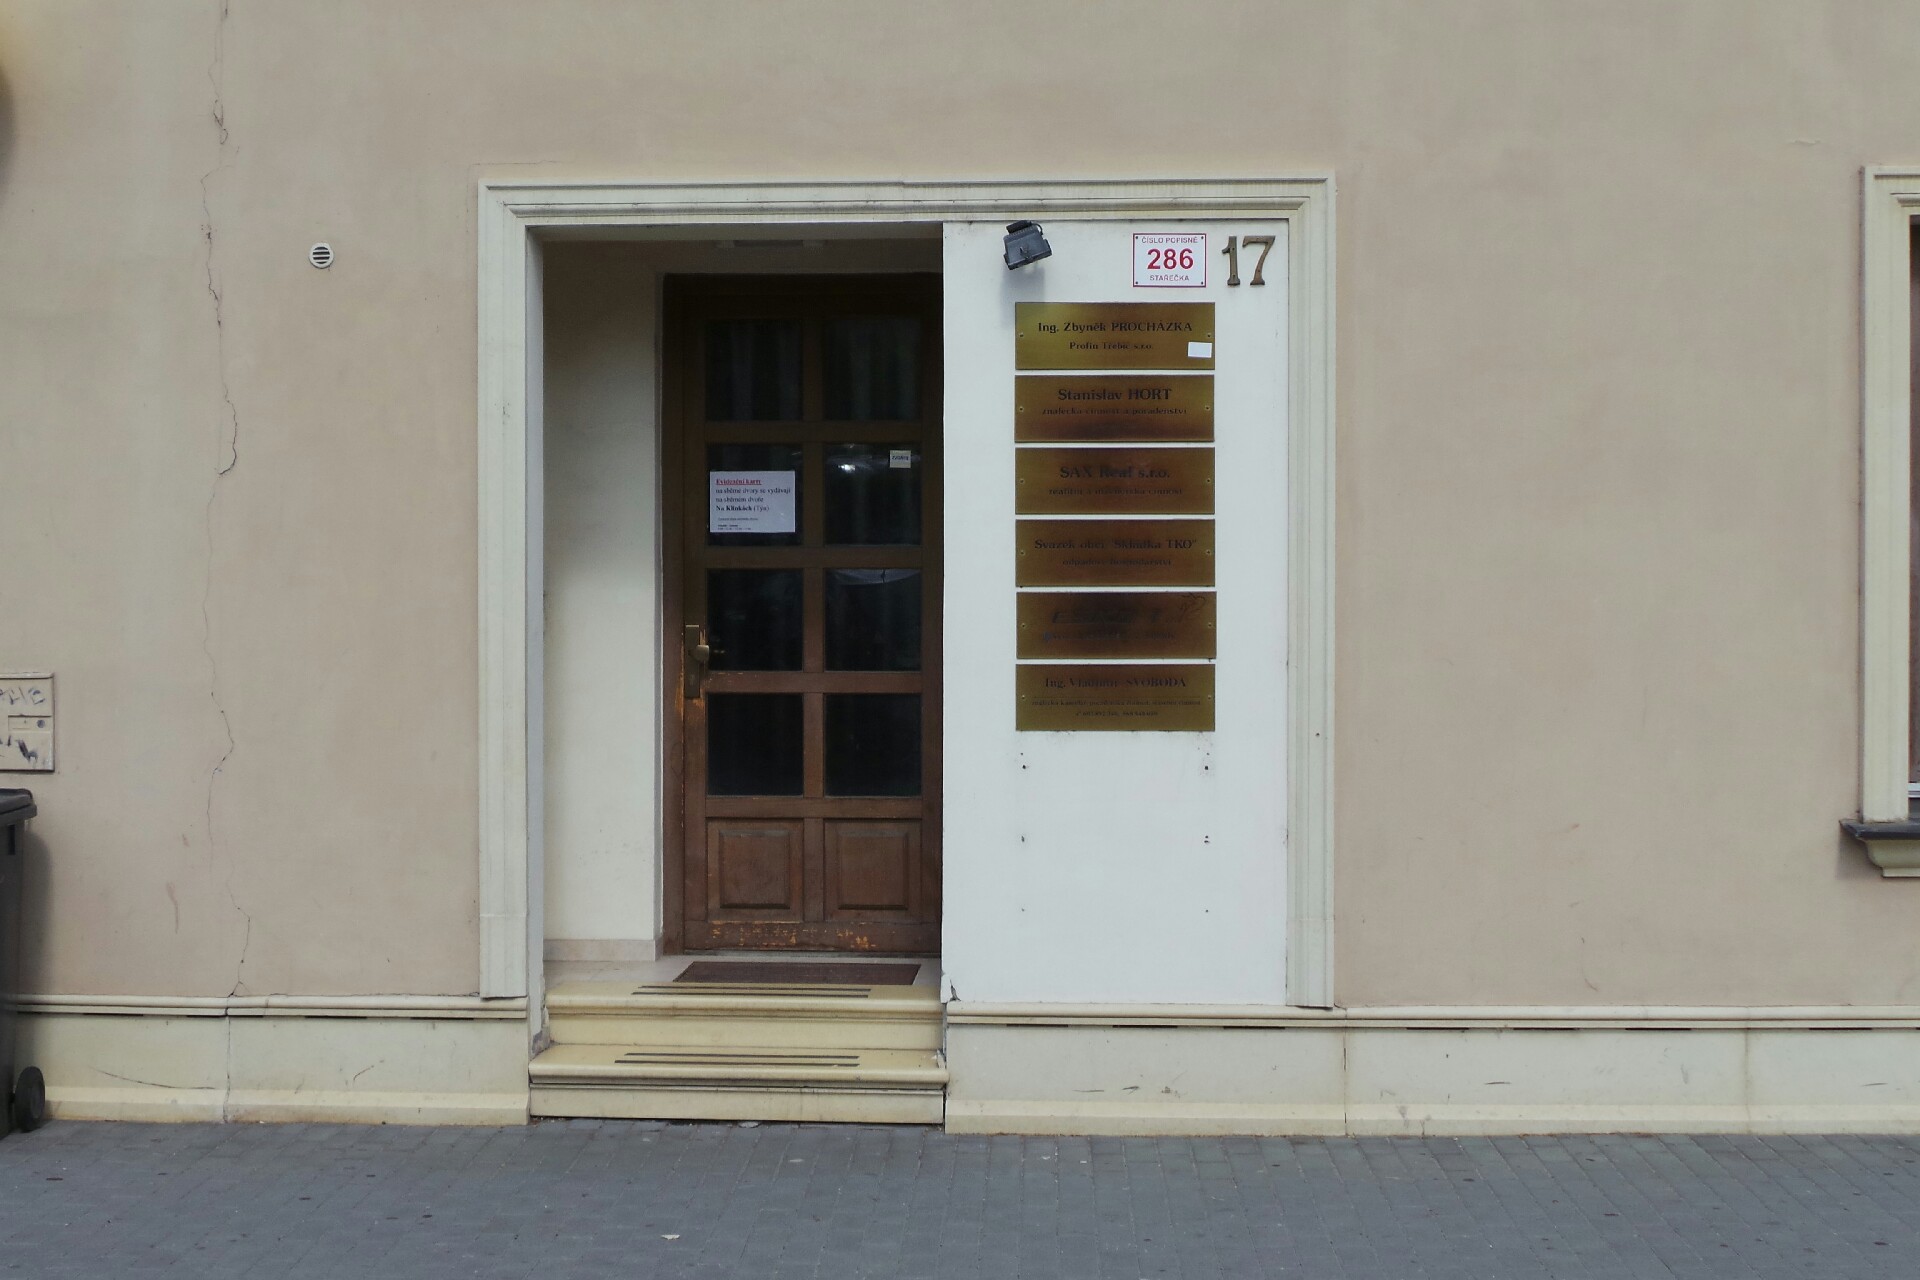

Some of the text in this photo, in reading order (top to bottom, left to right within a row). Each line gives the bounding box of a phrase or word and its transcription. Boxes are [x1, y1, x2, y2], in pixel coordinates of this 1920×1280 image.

[1141, 235, 1199, 244] ČÍSLO POPISNÉ
[1147, 248, 1194, 270] 286
[1222, 235, 1276, 286] 17
[1038, 319, 1193, 334] Ing. Zbyněk PROCHÁZKA
[1069, 341, 1099, 350] Profin
[1057, 388, 1173, 400] Stanislav HORT
[1059, 465, 1094, 479] SAX
[1137, 467, 1171, 479] s.r.o.
[1045, 677, 1066, 689] Ing.
[1125, 677, 1187, 688] SVOBODA
